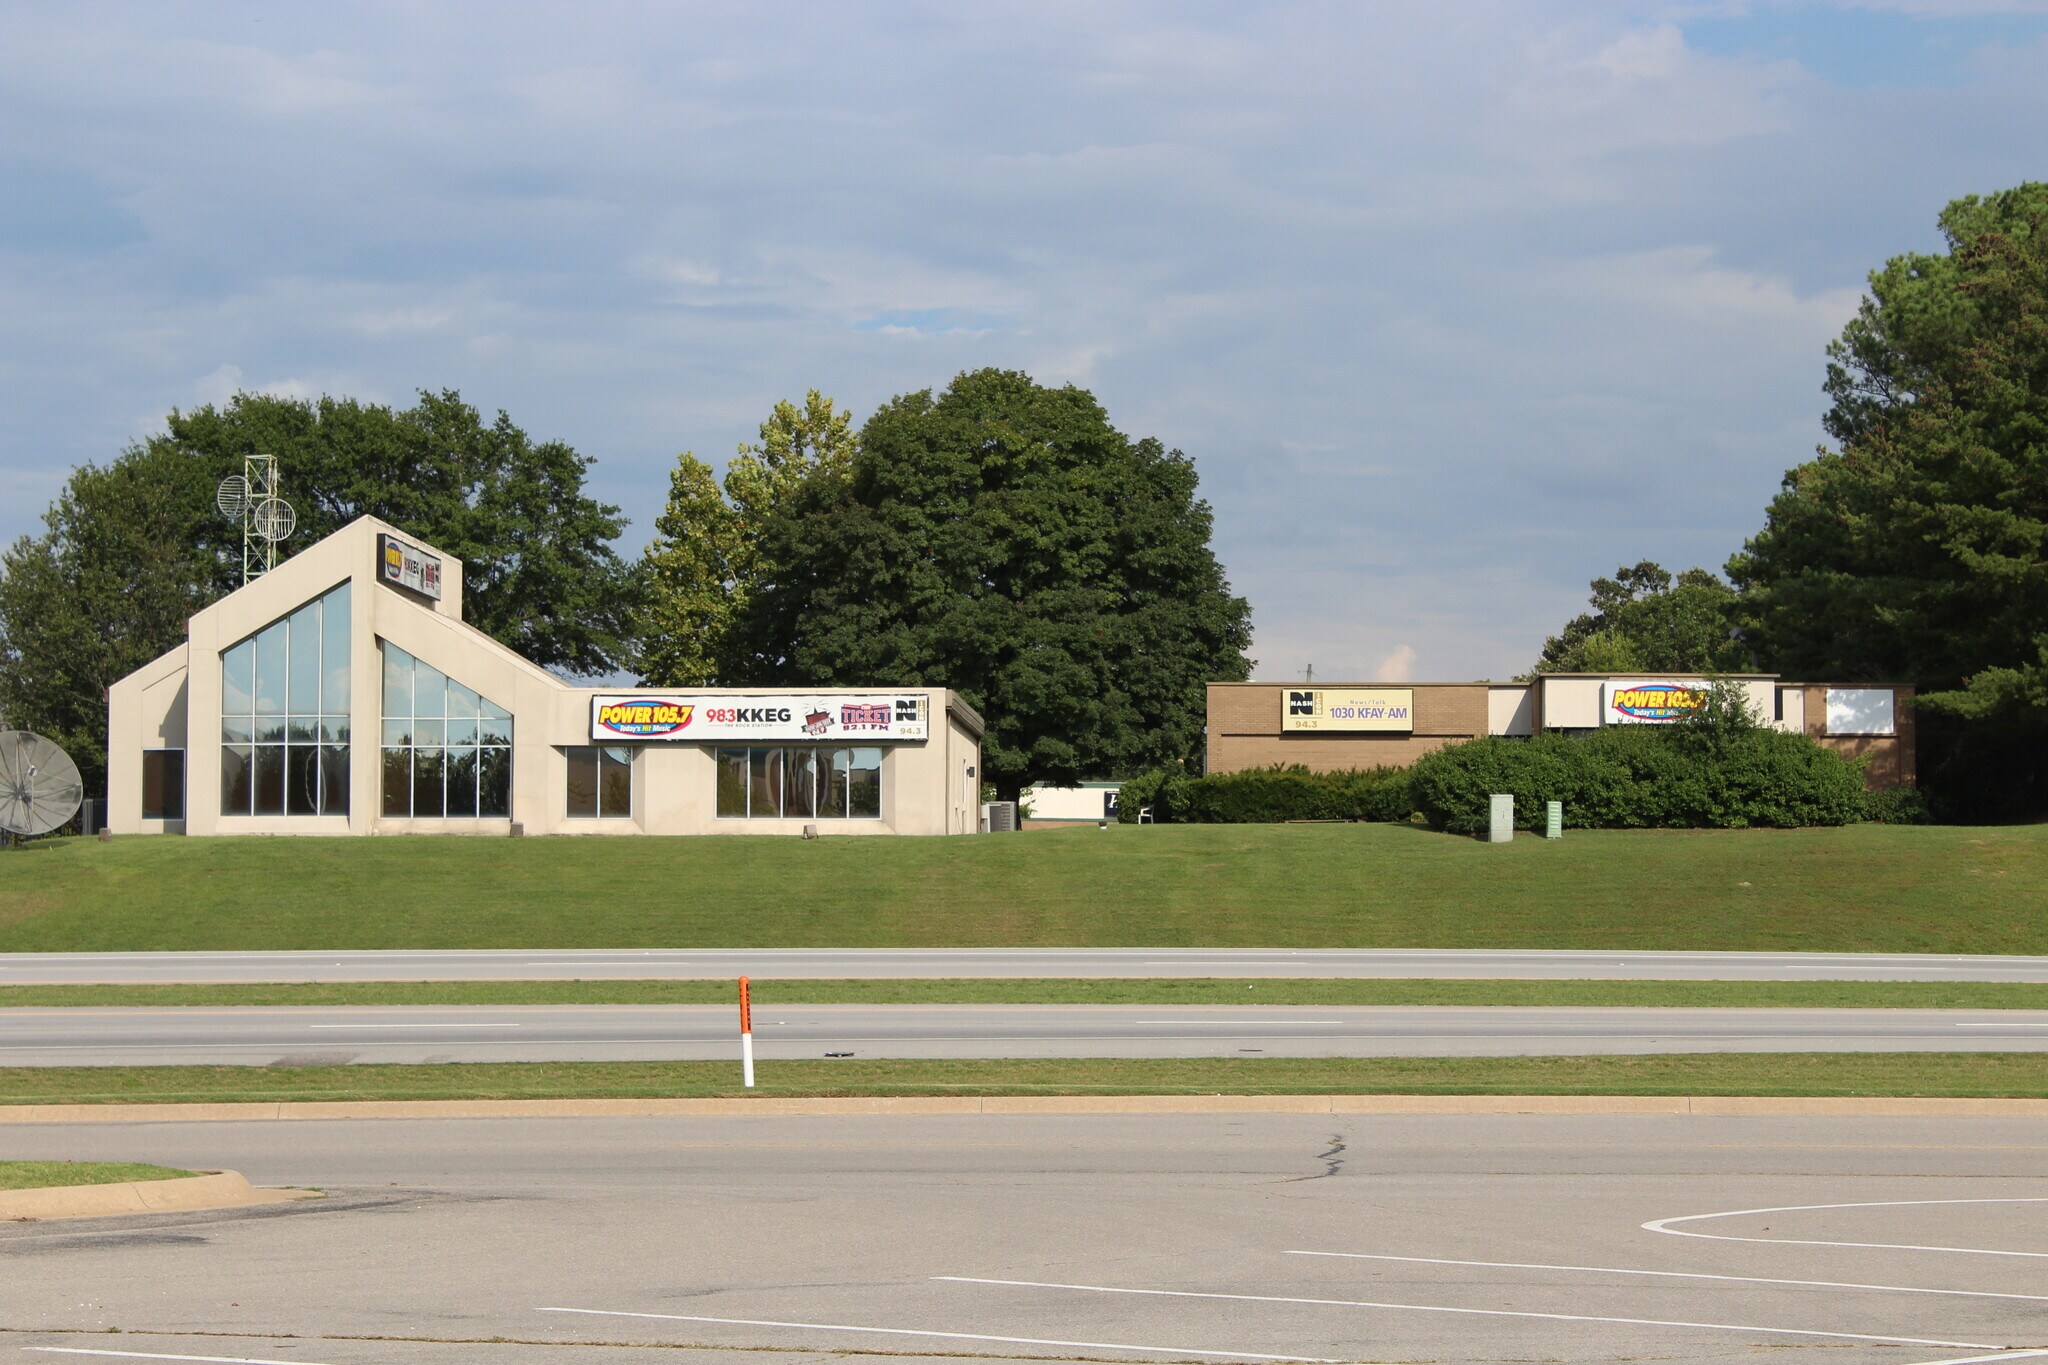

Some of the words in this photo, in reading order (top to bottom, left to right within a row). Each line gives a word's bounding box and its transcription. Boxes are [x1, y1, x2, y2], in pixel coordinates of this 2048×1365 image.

[1613, 690, 1665, 708] POWER
[599, 706, 652, 724] POWER
[652, 705, 694, 724] 105.7
[842, 708, 890, 724] TICKET
[1330, 707, 1355, 719] 1030
[1357, 707, 1407, 719] KFAY-AM
[1633, 709, 1655, 717] Today's
[620, 724, 641, 733] Today's
[1295, 720, 1318, 728] 94.3
[900, 727, 922, 735] 94.3
